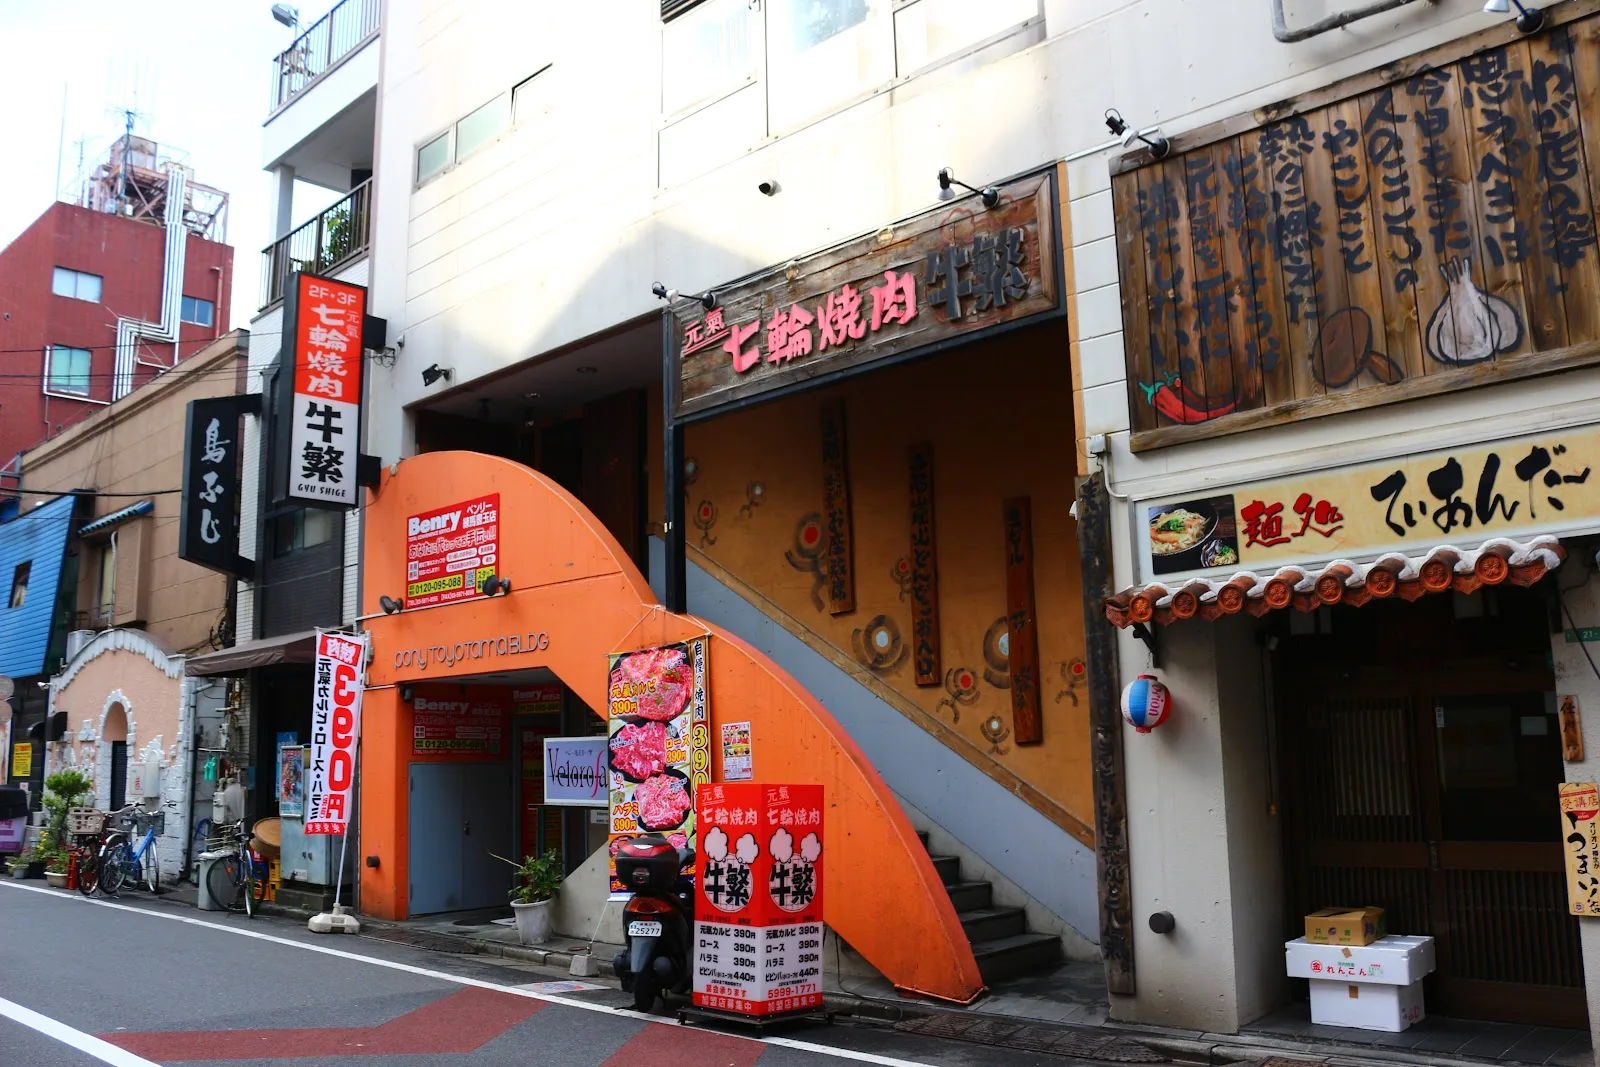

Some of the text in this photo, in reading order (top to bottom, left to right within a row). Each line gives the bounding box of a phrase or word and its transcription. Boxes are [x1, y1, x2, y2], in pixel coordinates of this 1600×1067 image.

[1406, 64, 1471, 253] 今日もまた
[1323, 119, 1373, 273] やさしさと
[723, 270, 919, 374] 七輪焼肉
[925, 227, 1028, 321] 牛繁
[307, 303, 350, 398] 七輪焼肉
[301, 401, 345, 484] 牛繁
[297, 483, 347, 497] GYU SHIGE
[466, 501, 493, 515] ベンリー
[408, 510, 462, 536] Benry
[415, 576, 462, 594] 0120-095-088
[694, 640, 705, 720] 自慢の焼肉
[611, 678, 657, 699] 元氣カルビ
[414, 697, 469, 715] Benry
[610, 699, 637, 715] 390円
[665, 735, 691, 749] ロース
[665, 749, 688, 764] 390円
[692, 726, 707, 790] 390
[701, 785, 725, 802] 元氣
[767, 786, 790, 803] 元氣
[613, 802, 640, 817] ハラミ
[1561, 795, 1599, 810] 受講店
[613, 818, 637, 831] 390円
[701, 807, 758, 826] 七輪焼肉
[766, 807, 820, 826] 七輪焼肉
[704, 862, 750, 906] 牛繁
[770, 863, 814, 906] 牛繁
[635, 927, 660, 935] 25277
[700, 925, 756, 940] 元氣カルビ 390円
[766, 926, 820, 940] 元氣カルビ 390円
[700, 939, 756, 954] ロース 390円
[766, 939, 819, 953] ロース 390円
[700, 953, 756, 968] ハラミ 390円
[766, 953, 819, 968] ハラミ 390円
[733, 971, 756, 983] 440円
[798, 967, 819, 977] 440円
[1312, 961, 1321, 971] 金
[1327, 965, 1367, 977] れんこん
[767, 984, 816, 998] 5999-1771
[701, 995, 752, 1011] 加盟店募集中
[767, 995, 816, 1012] 加盟店募集中
